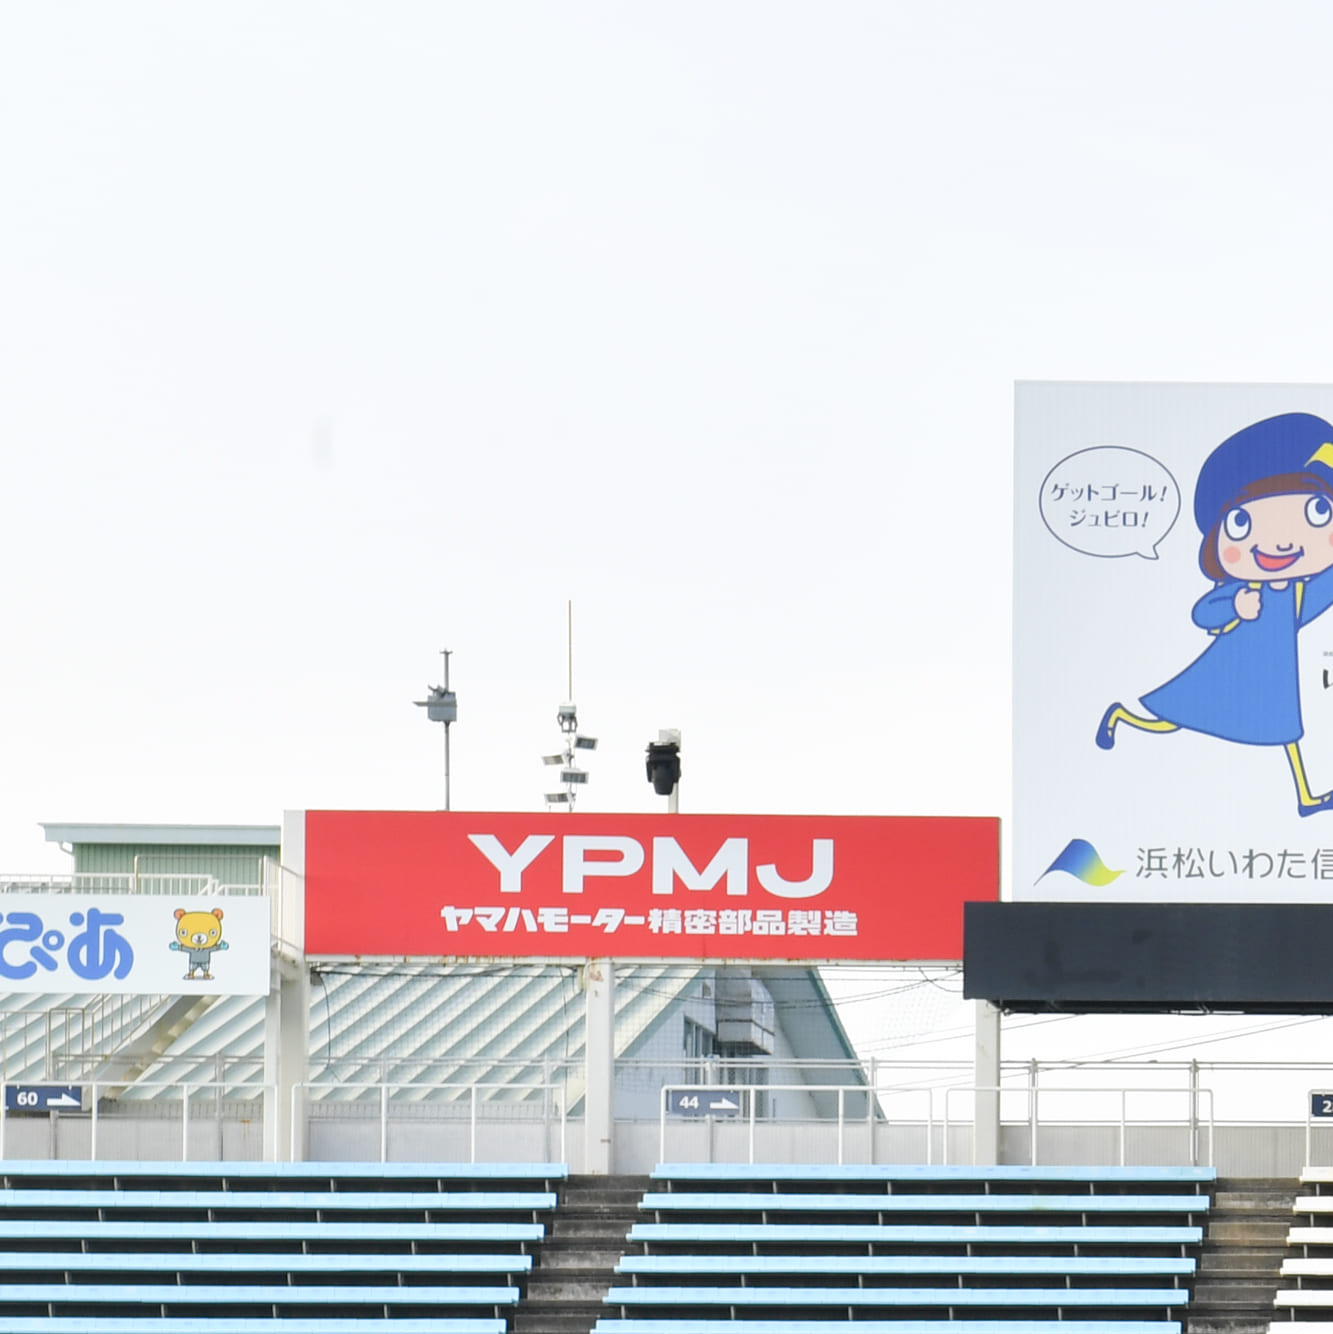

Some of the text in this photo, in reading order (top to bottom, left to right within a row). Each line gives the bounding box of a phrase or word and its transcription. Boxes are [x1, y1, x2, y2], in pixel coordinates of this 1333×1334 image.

[468, 834, 835, 898] YPMJ
[440, 905, 858, 937] ヤマハモーター精密部品製造
[17, 1092, 38, 1106] 60
[680, 1096, 699, 1109] 44
